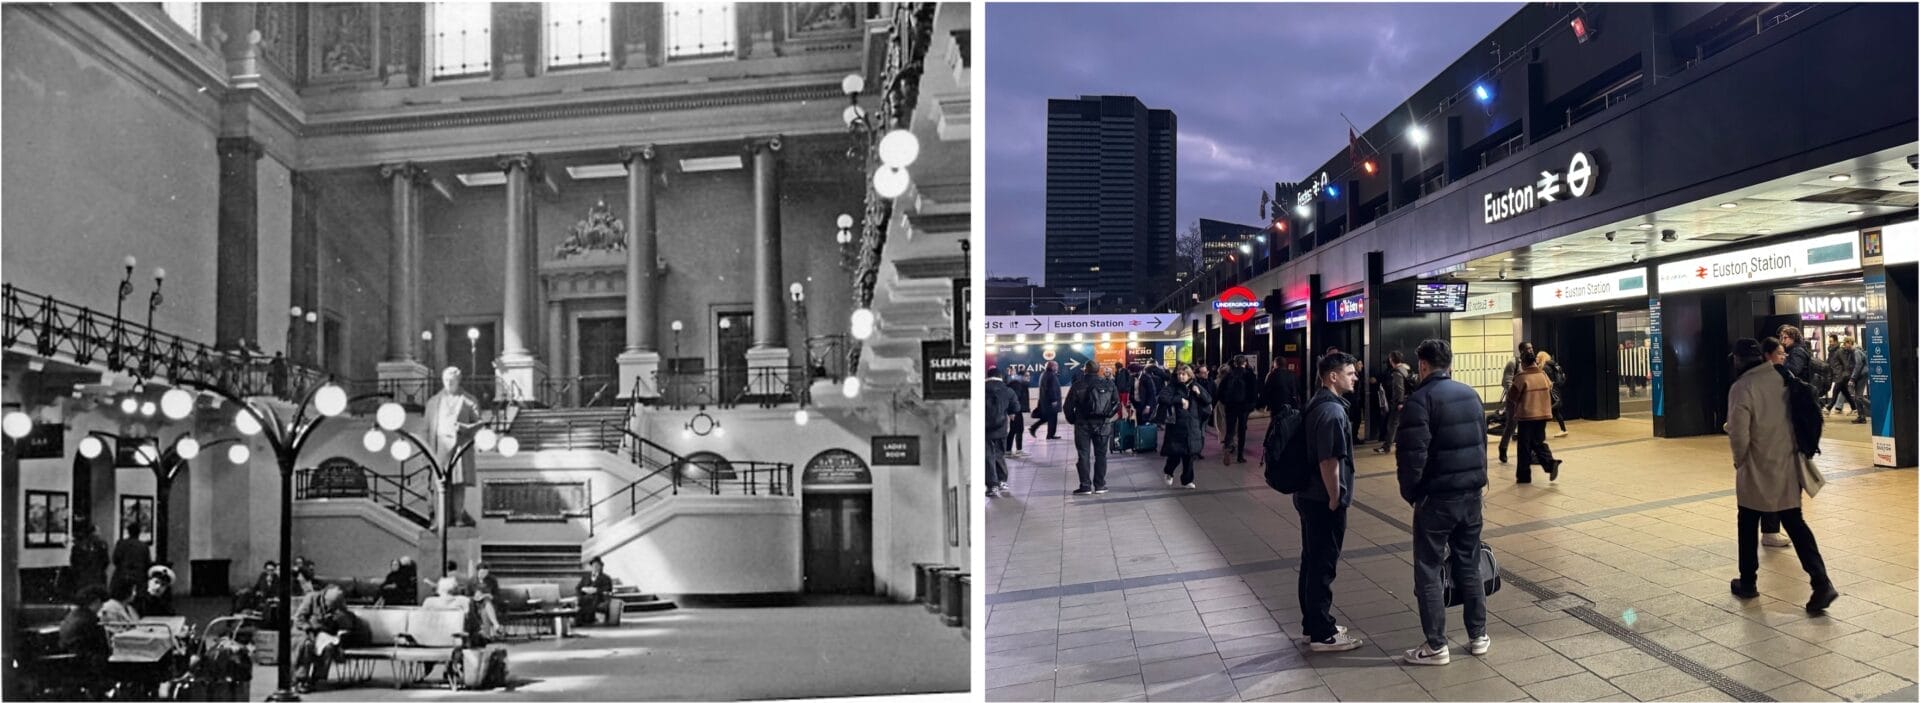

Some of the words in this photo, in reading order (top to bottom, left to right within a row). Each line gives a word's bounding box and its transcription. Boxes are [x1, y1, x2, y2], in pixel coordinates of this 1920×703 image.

[1485, 185, 1533, 224] Euston
[1713, 263, 1748, 278] Euston
[1750, 254, 1792, 273] Station
[1565, 286, 1586, 298] Euston
[1587, 282, 1611, 296] Station
[992, 321, 1003, 329] St
[1054, 320, 1088, 328] Euston
[1090, 320, 1124, 328] Station
